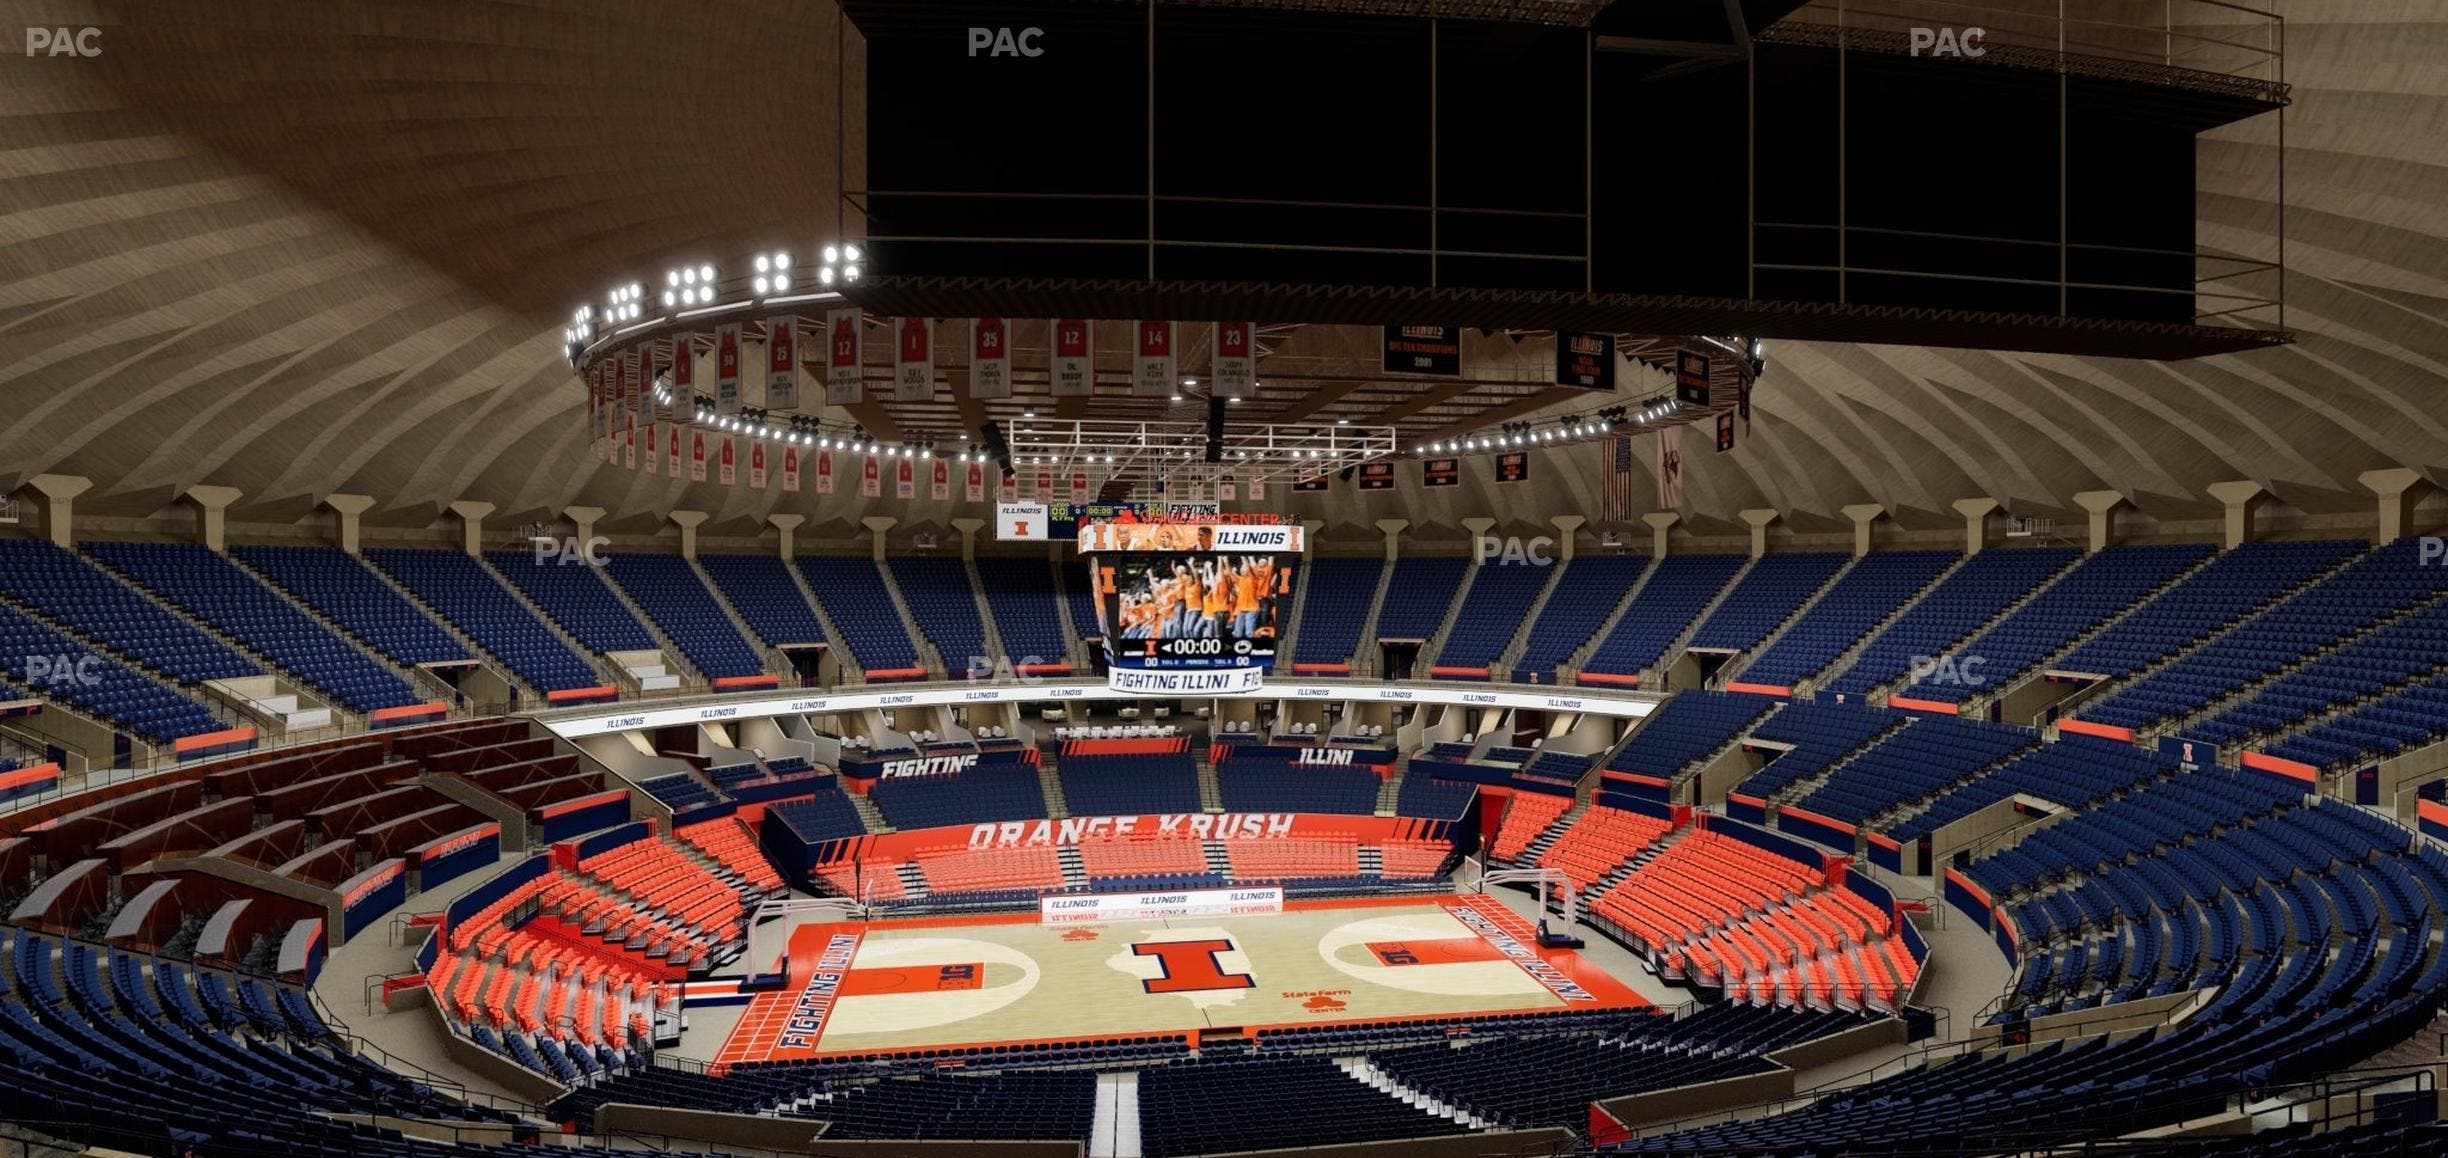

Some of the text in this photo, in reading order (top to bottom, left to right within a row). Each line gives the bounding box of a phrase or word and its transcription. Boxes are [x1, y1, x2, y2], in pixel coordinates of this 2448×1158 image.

[983, 332, 997, 348] 35
[1065, 331, 1079, 345] 12
[1148, 331, 1163, 345] 14
[1226, 330, 1240, 346] 23
[1219, 512, 1280, 525] CENTER
[1217, 532, 1285, 545] ILLINOIS
[1174, 639, 1221, 655] 00:00
[1145, 657, 1158, 667] 00
[1236, 656, 1249, 666] 00
[1115, 672, 1230, 689] FIGHTING ILLINI
[966, 691, 999, 700] ILLINOIS
[1050, 689, 1083, 697] ILLINOIS
[1297, 689, 1330, 697] ILLINOIS
[1380, 691, 1413, 699] ILLINOIS
[880, 695, 914, 704] ILLINOIS
[1463, 694, 1496, 703] ILLINOIS
[1548, 699, 1582, 708] ILLINOIS
[791, 700, 827, 710] ILLINOIS
[701, 707, 737, 718] ILLINOIS
[607, 717, 645, 729] ILLINOIS
[1299, 748, 1354, 766] ILLINI
[967, 813, 1296, 850] ORANGE KRUSH
[1141, 895, 1188, 905] ILLINOIS
[1230, 892, 1275, 901] ILLINOIS
[1052, 899, 1099, 909] ILLINOIS
[778, 934, 860, 1048] FIGHTING ILLINI
